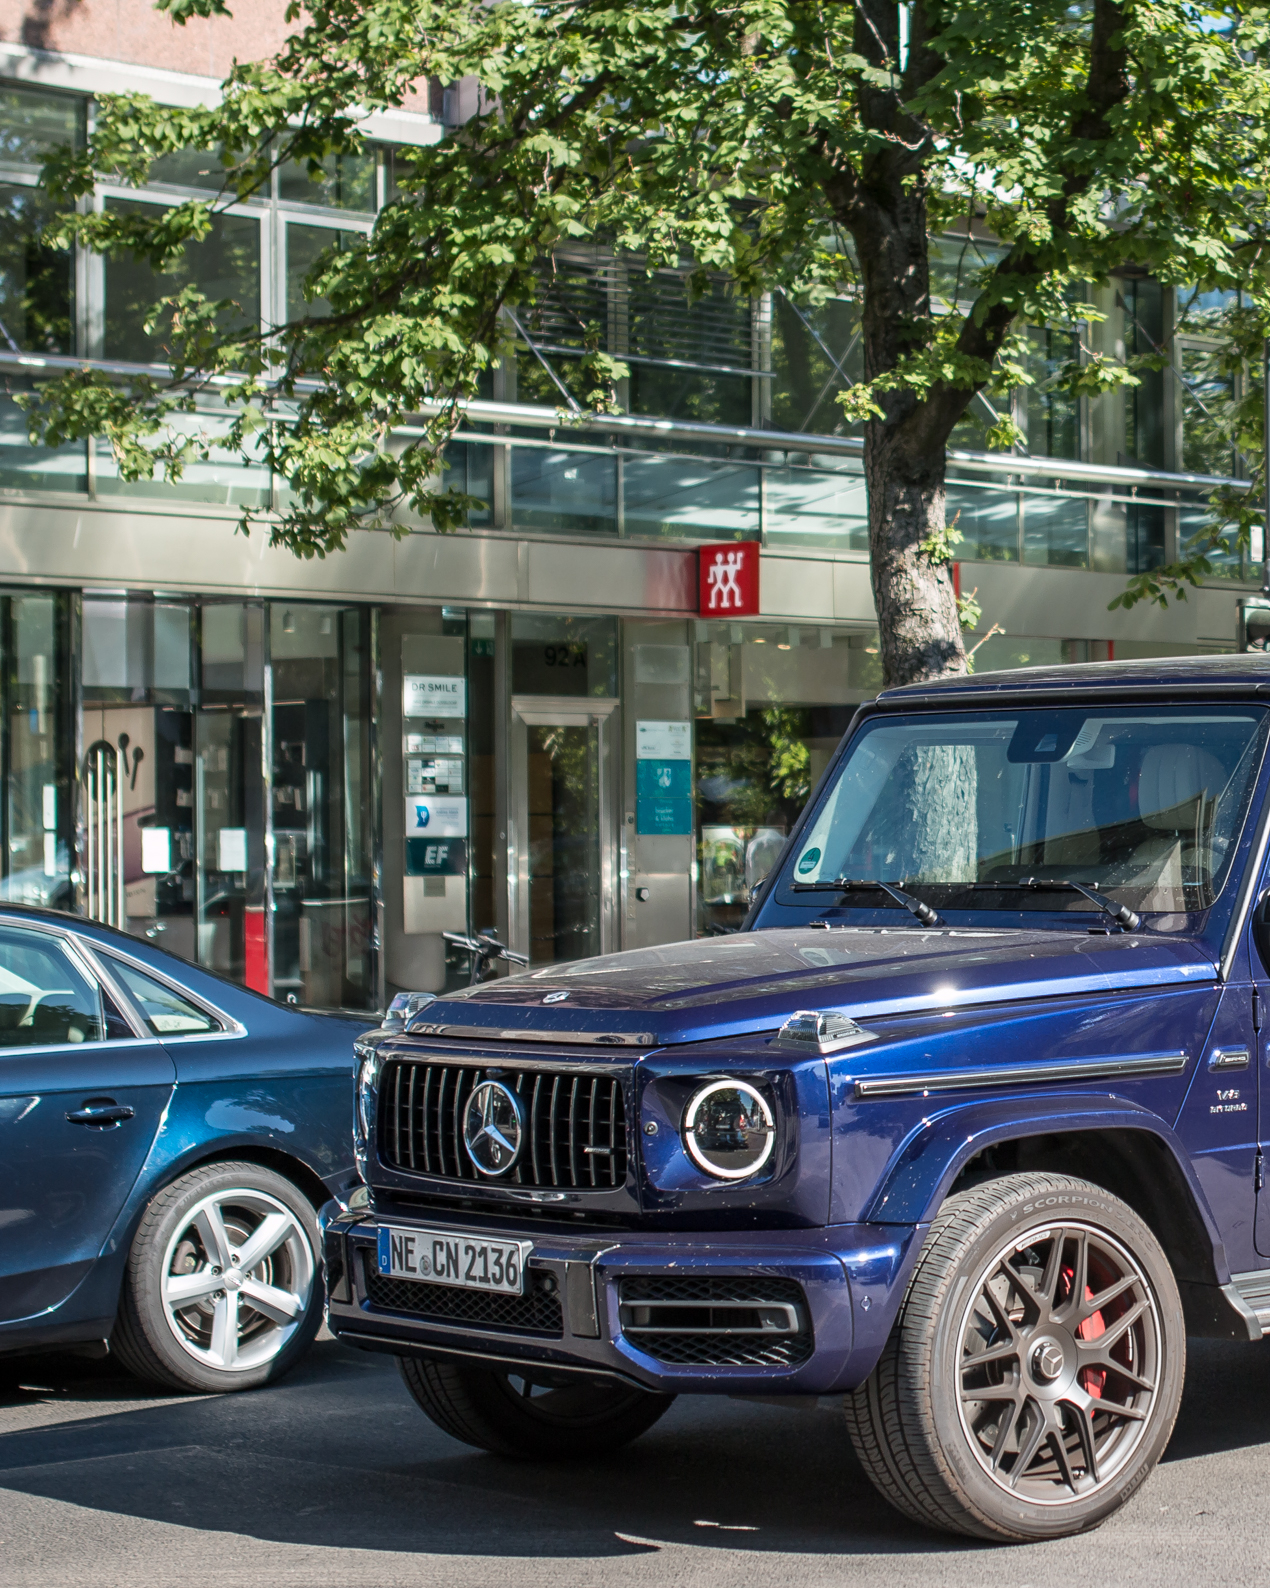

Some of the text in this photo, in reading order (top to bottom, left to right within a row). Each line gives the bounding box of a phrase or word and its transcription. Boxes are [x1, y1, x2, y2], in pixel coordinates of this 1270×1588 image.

[411, 682, 458, 693] DR SMILE
[424, 845, 449, 865] EF
[1022, 1195, 1114, 1215] SCORPION
[381, 1255, 388, 1266] D
[391, 1234, 518, 1287] NE CN 2136
